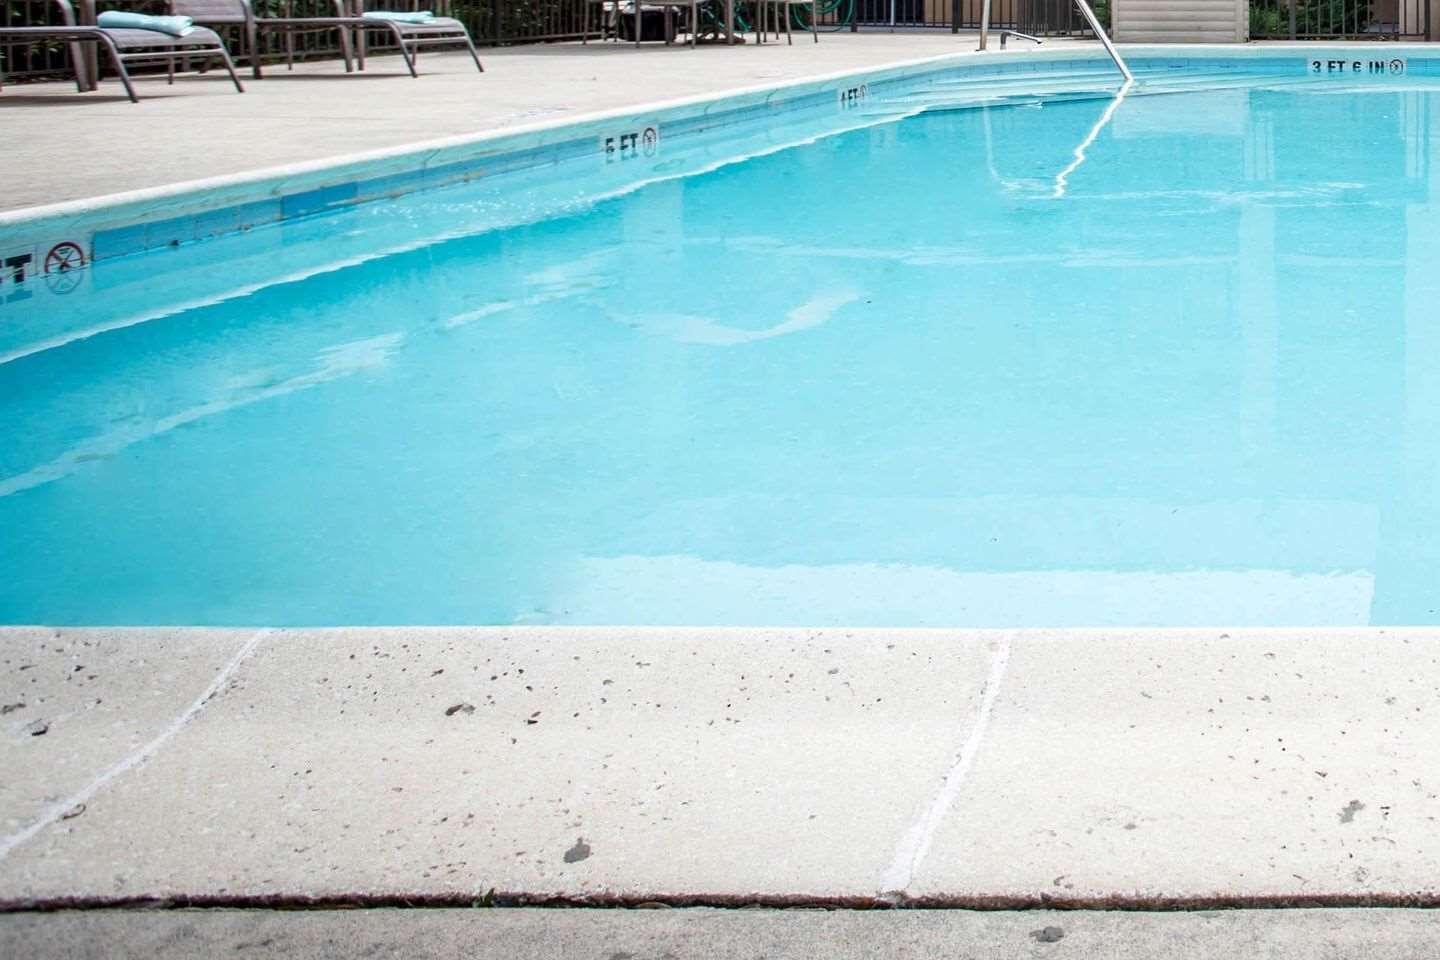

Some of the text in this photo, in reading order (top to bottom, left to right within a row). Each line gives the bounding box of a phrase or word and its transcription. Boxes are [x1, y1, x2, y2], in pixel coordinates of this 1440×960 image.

[1312, 60, 1322, 73] 3
[1327, 60, 1346, 73] FT
[1369, 61, 1385, 74] IN
[620, 133, 639, 150] FT
